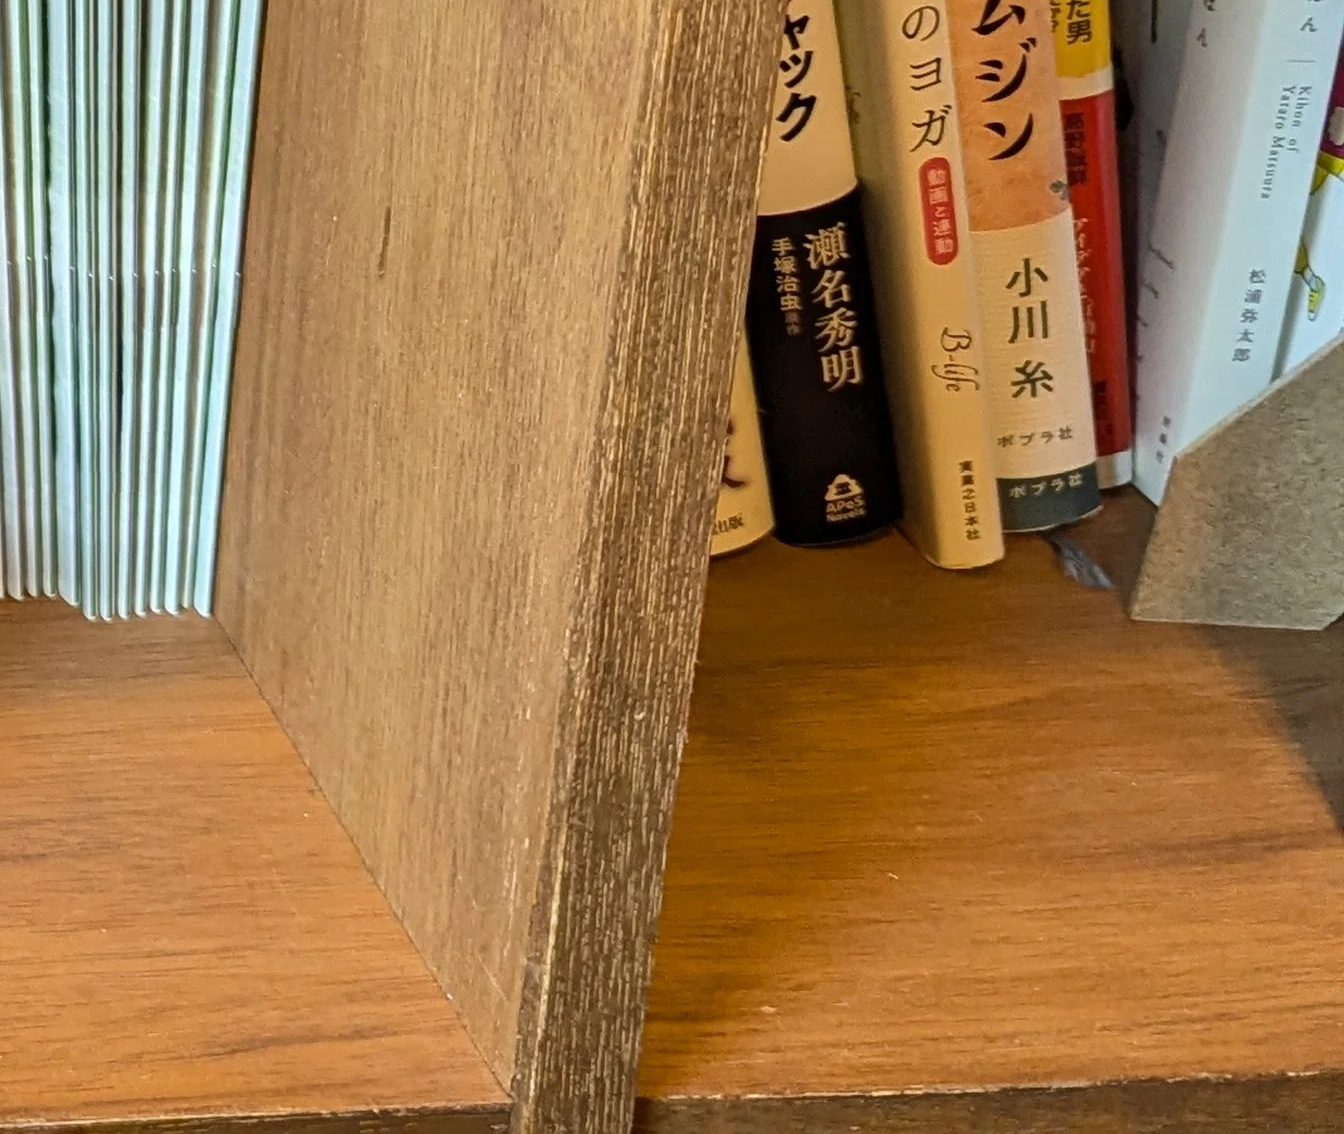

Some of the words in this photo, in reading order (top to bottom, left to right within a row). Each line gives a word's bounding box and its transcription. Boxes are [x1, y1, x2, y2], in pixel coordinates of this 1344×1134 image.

[803, 221, 863, 393] 瀬名秀明
[1005, 257, 1053, 399] 小川糸
